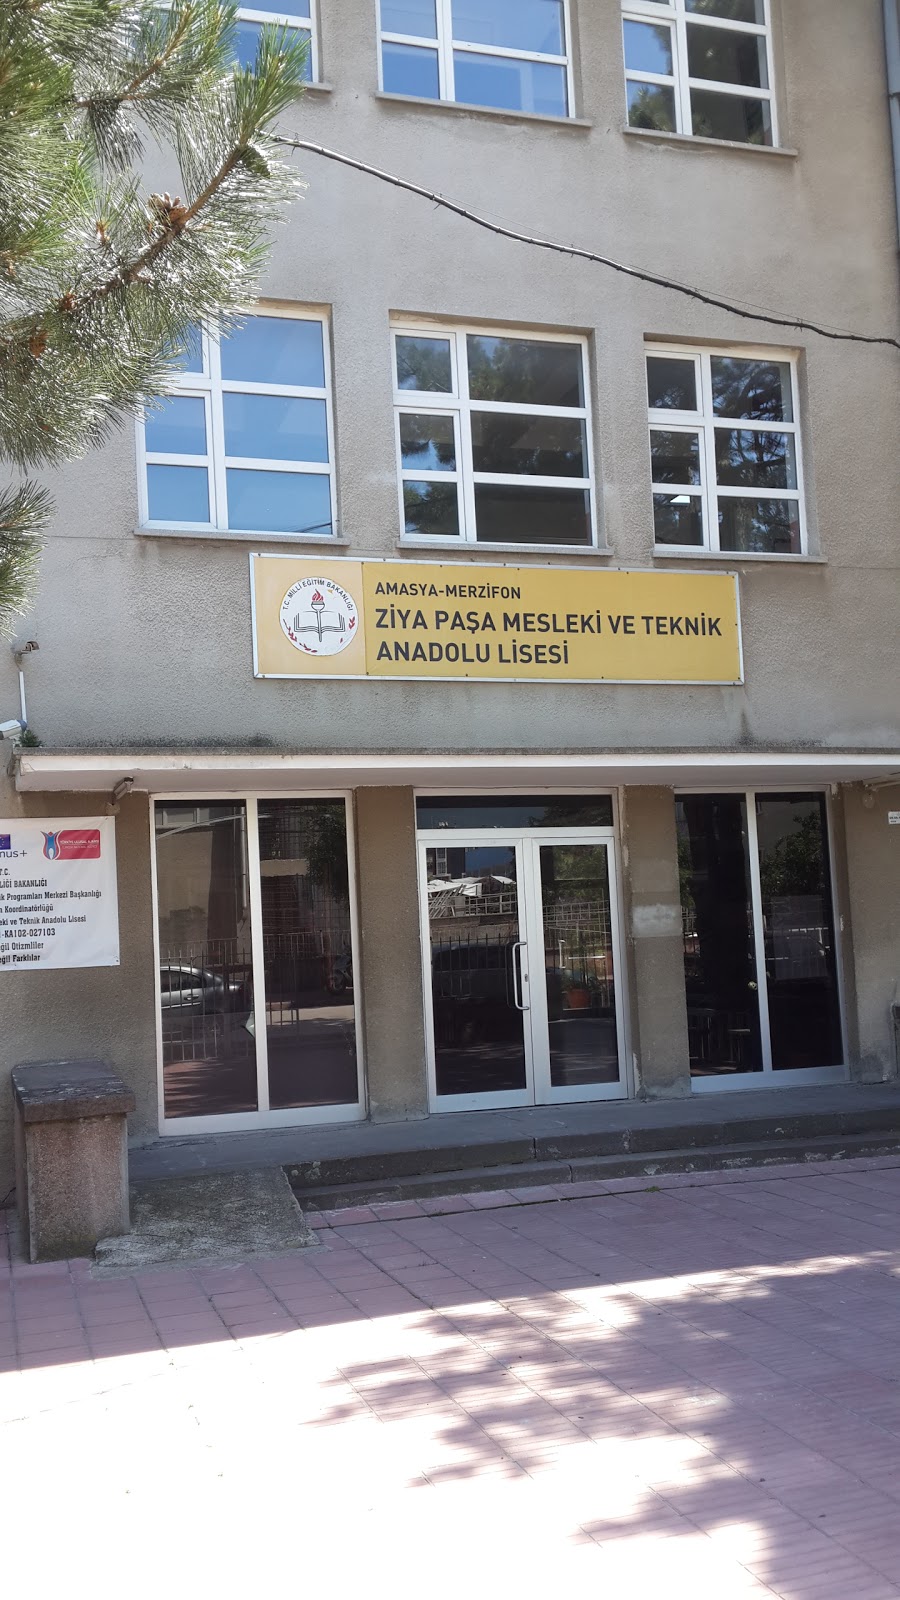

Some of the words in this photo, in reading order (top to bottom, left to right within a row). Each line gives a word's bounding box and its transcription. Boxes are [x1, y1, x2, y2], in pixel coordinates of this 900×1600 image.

[326, 581, 354, 611] BAKANLIĞI
[376, 582, 521, 599] AMASYA-MERZİFON
[376, 604, 428, 629] ZİYA
[435, 610, 496, 634] PAŞA
[503, 610, 602, 633] MESLEKİ
[608, 615, 636, 634] VE
[642, 613, 722, 636] TEKNİK
[377, 641, 490, 662] ANADOLU
[498, 639, 569, 664] LİSESİ
[13, 878, 48, 888] BAKANLIĞI
[44, 891, 68, 899] Merkezi
[69, 890, 102, 900] Başkanlığı
[19, 916, 41, 925] Teknik
[41, 915, 67, 924] Anadolu
[68, 914, 87, 923] Lisesi
[11, 941, 44, 951] Otizmliler
